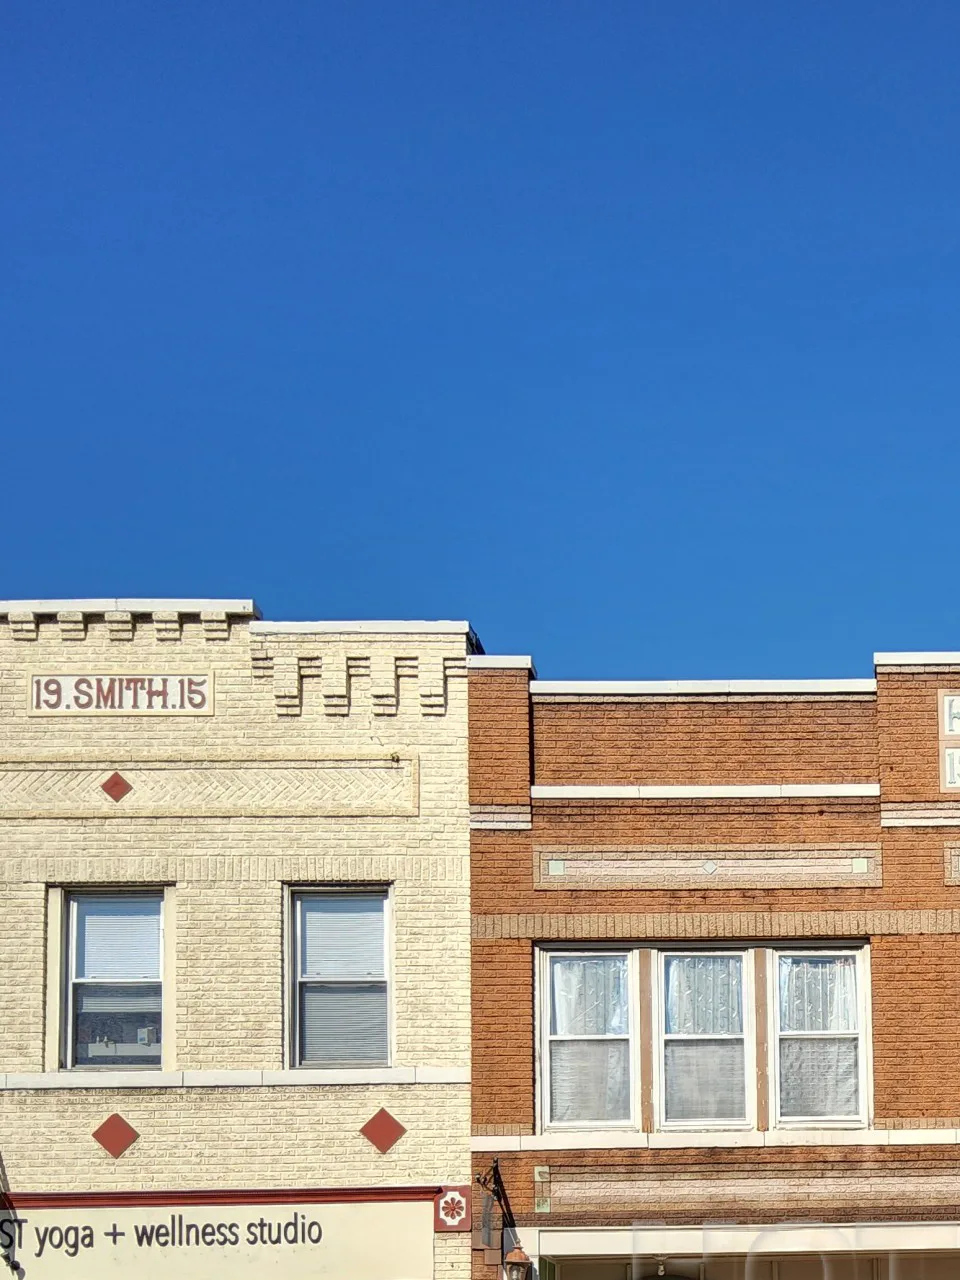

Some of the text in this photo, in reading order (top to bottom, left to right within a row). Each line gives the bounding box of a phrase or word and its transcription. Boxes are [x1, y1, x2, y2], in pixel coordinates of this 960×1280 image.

[34, 1224, 95, 1257] yoga
[134, 1213, 240, 1247] wellness
[246, 1211, 323, 1245] studio
